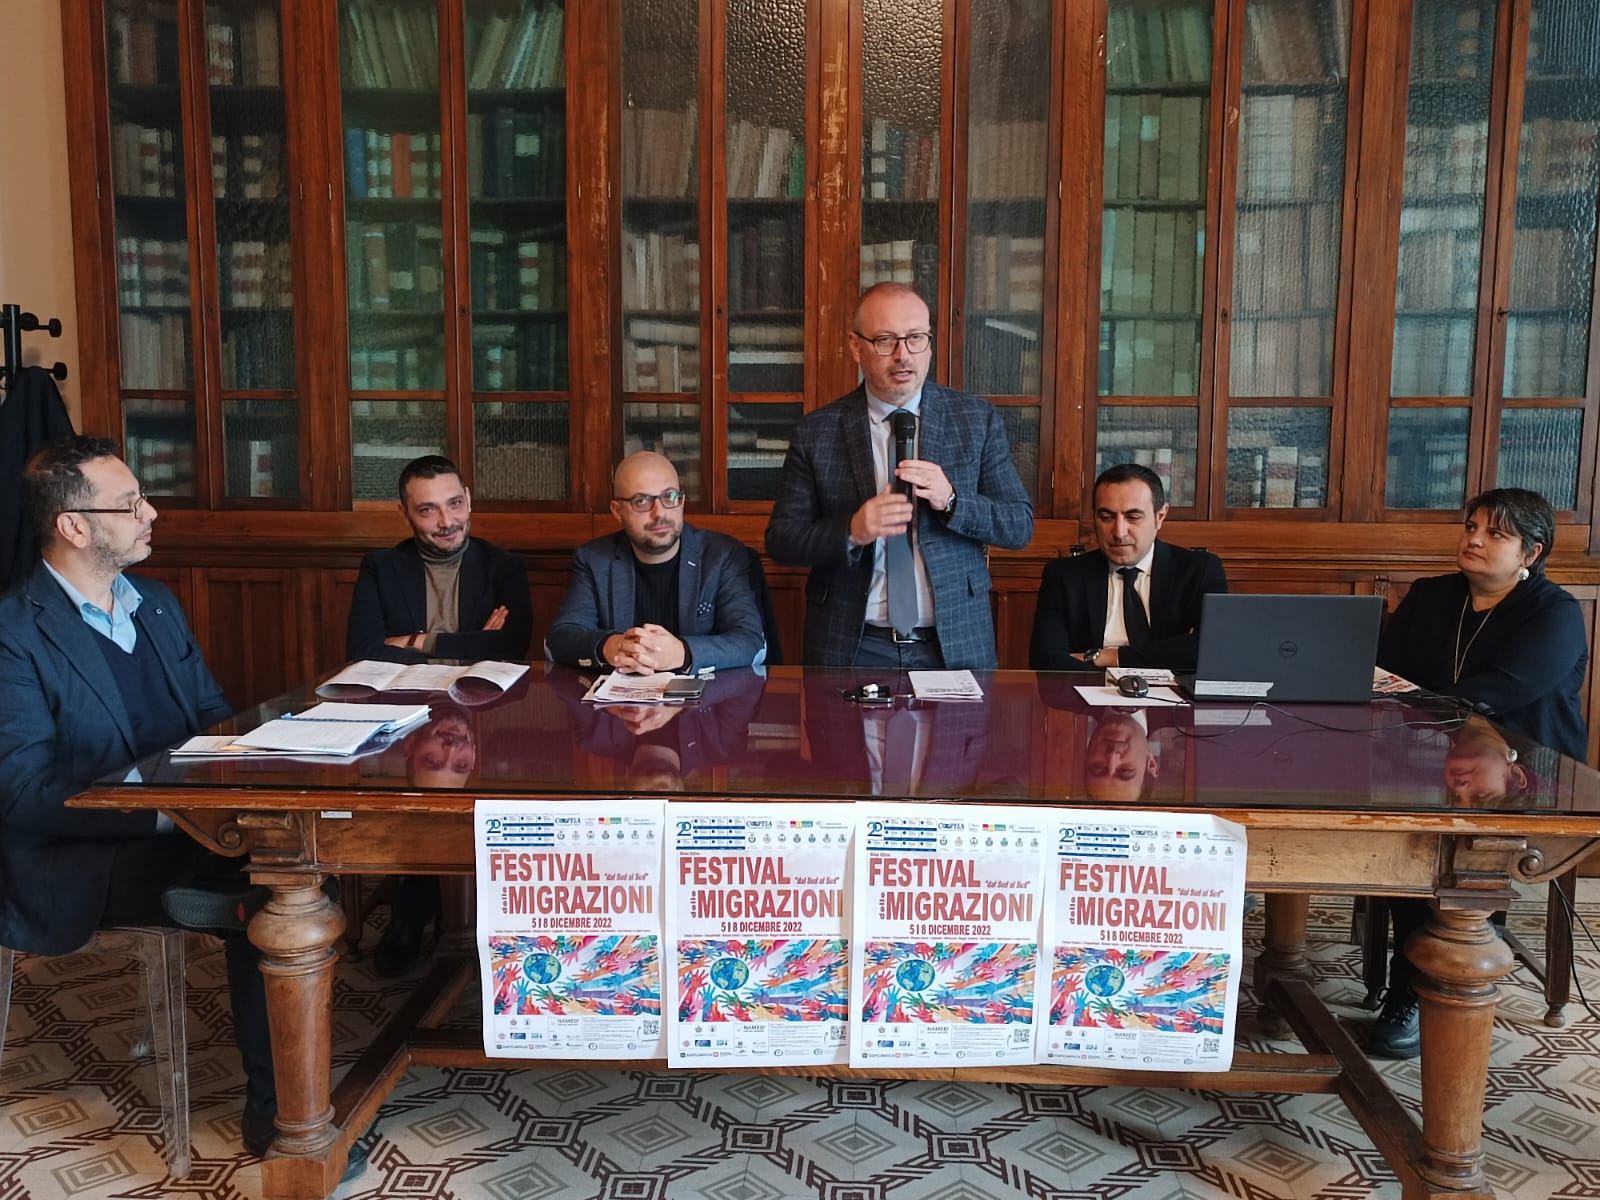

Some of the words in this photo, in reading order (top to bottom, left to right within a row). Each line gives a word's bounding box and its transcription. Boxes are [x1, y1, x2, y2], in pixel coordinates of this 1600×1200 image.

[490, 853, 600, 881] FESTIVAL
[679, 857, 791, 885] FESTIVAL
[869, 858, 981, 887] FESTIVAL
[1059, 863, 1173, 896] FESTIVAL
[509, 885, 653, 914] MIGRAZIONI
[697, 889, 843, 918] MIGRAZIONI
[886, 891, 1033, 921] MIGRAZIONI
[1076, 896, 1227, 931] MIGRAZIONI
[532, 918, 537, 928] 5
[543, 918, 548, 928] 8
[550, 918, 591, 928] DICEMBRE
[593, 918, 612, 928] 2022
[721, 922, 726, 932] 5
[733, 922, 738, 932] 8
[740, 922, 781, 932] DICEMBRE
[783, 922, 802, 932] 2022
[909, 925, 915, 935] 5
[921, 925, 927, 935] 8
[928, 925, 970, 935] DICEMBRE
[972, 925, 991, 936] 2022
[1100, 930, 1105, 941] 5
[1111, 931, 1117, 941] 8
[1119, 931, 1162, 943] DICEMBRE
[1164, 933, 1183, 944] 2022
